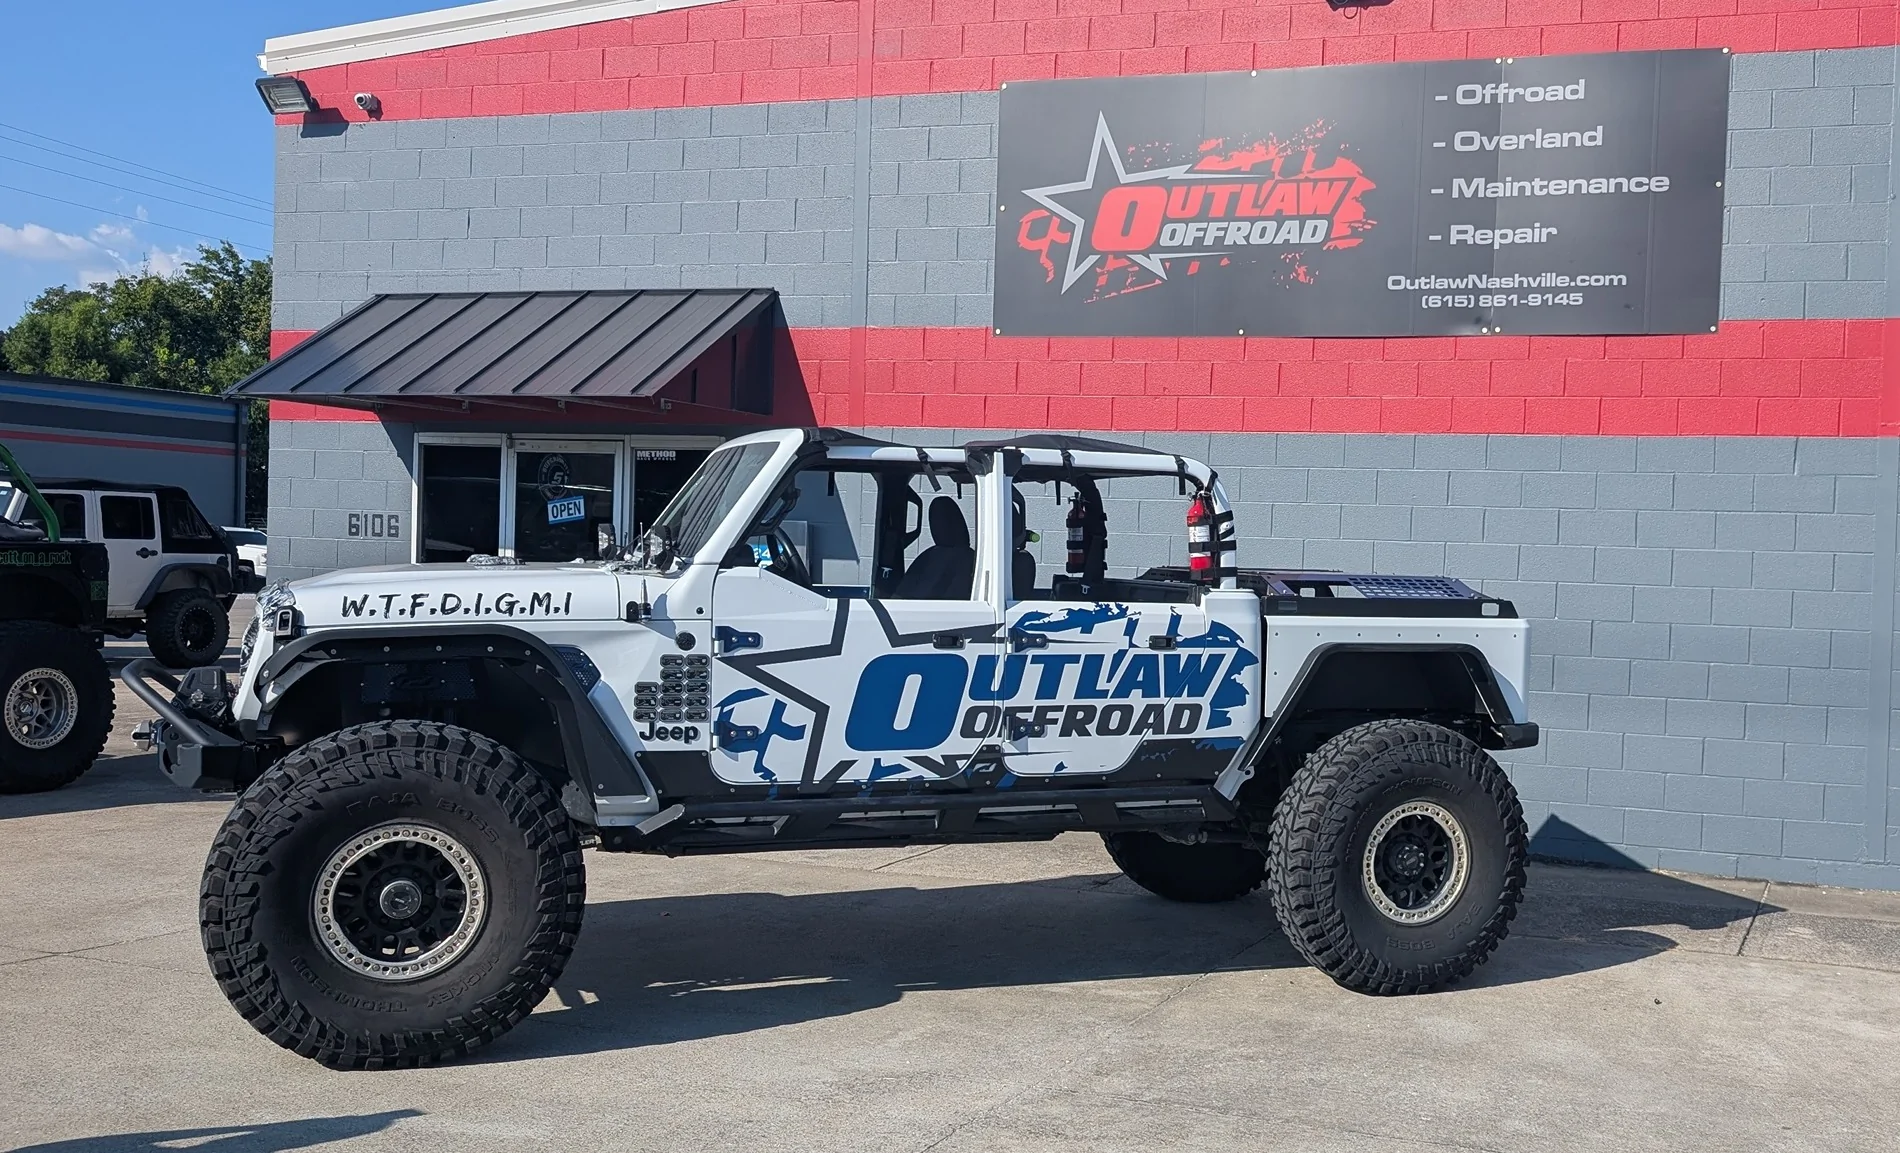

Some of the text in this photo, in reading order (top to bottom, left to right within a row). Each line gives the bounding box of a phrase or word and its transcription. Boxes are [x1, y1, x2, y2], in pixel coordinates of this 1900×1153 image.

[1456, 79, 1586, 106] Offroad
[1453, 125, 1604, 152] Overland
[1451, 175, 1670, 200] Maintenance
[1092, 180, 1350, 250] OUTLAW
[1159, 219, 1329, 247] OFFROAD
[1449, 222, 1558, 249] Repair
[1387, 273, 1627, 292] OutlawNashville.com
[1421, 291, 1584, 309] (615) 861-9145
[636, 450, 677, 458] METHOD
[551, 500, 582, 519] OPEN
[348, 513, 400, 538] 6106
[341, 591, 572, 618] W.T.F.D.I.G.M.I
[846, 653, 1227, 751] OUTLAW
[639, 721, 699, 744] Jeep
